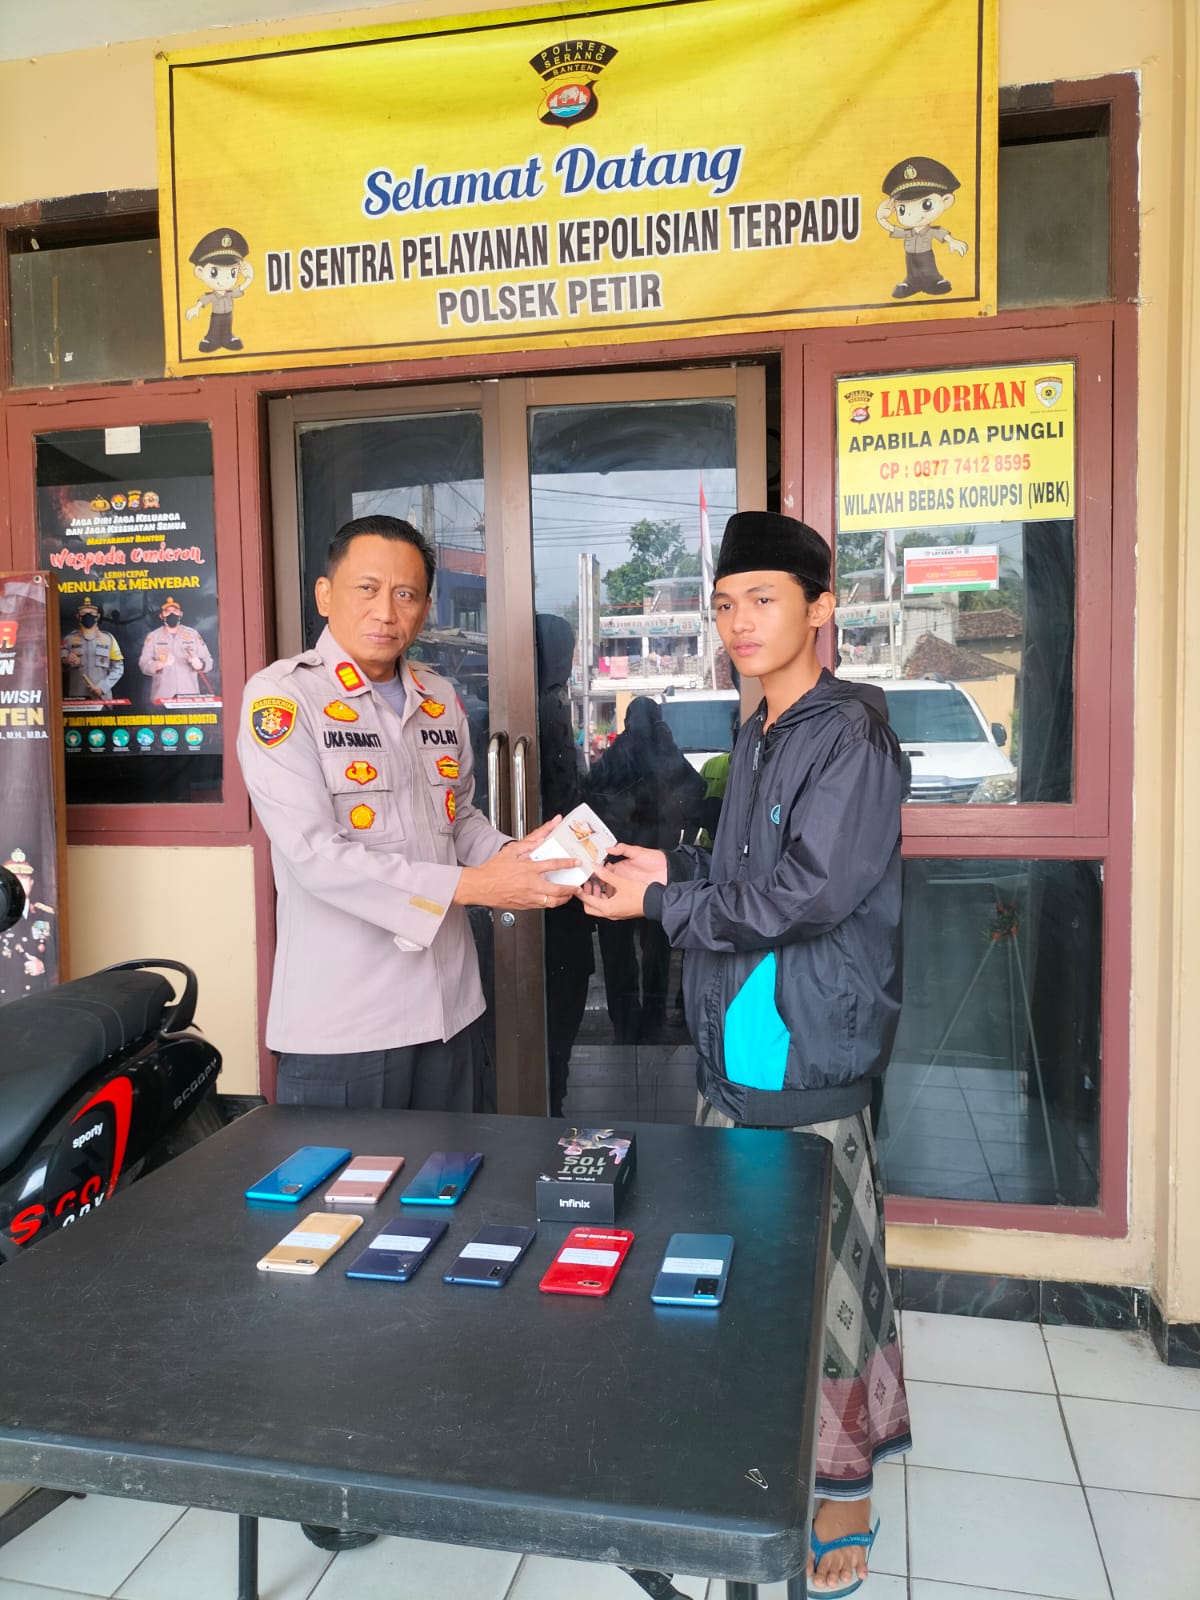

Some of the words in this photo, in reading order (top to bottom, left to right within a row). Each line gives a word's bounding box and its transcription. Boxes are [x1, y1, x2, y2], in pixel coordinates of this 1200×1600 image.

[540, 41, 607, 61] POLRES
[543, 51, 604, 69] SERANG
[552, 64, 594, 76] BANTEN
[363, 157, 544, 216] Selamat
[554, 147, 742, 195] Datang
[267, 252, 291, 292] DI
[300, 242, 394, 290] SENTRA
[402, 224, 549, 280] PELAYANAN
[558, 208, 720, 265] KEPOLISIAN
[728, 197, 860, 250] TERPADU
[438, 282, 559, 326] POLSEK
[567, 273, 662, 315] PETIR
[880, 380, 1026, 418] LAPORKAN
[848, 430, 933, 453] APABILA
[938, 427, 980, 446] ADA
[986, 421, 1064, 443] PUNGLI
[879, 462, 900, 481] CP
[913, 459, 949, 478] 0877
[954, 456, 991, 475] 7412
[994, 453, 1031, 473] 8595
[843, 491, 904, 517] WILAYAH
[908, 487, 955, 512] BEBAS
[959, 483, 1023, 509] KORUPSI
[1027, 480, 1071, 510] (WBK)
[135, 512, 181, 523] KELUARGA
[50, 545, 126, 575] Waspada
[130, 542, 205, 566] Omicron
[117, 579, 127, 590] &
[129, 575, 201, 591] MENYEBAR
[323, 731, 346, 748] UKA
[420, 729, 459, 745] POLRI
[72, 1122, 104, 1149] sporty
[557, 1166, 604, 1176] HOT
[563, 1155, 608, 1167] 10S
[559, 1198, 591, 1210] Infinix
